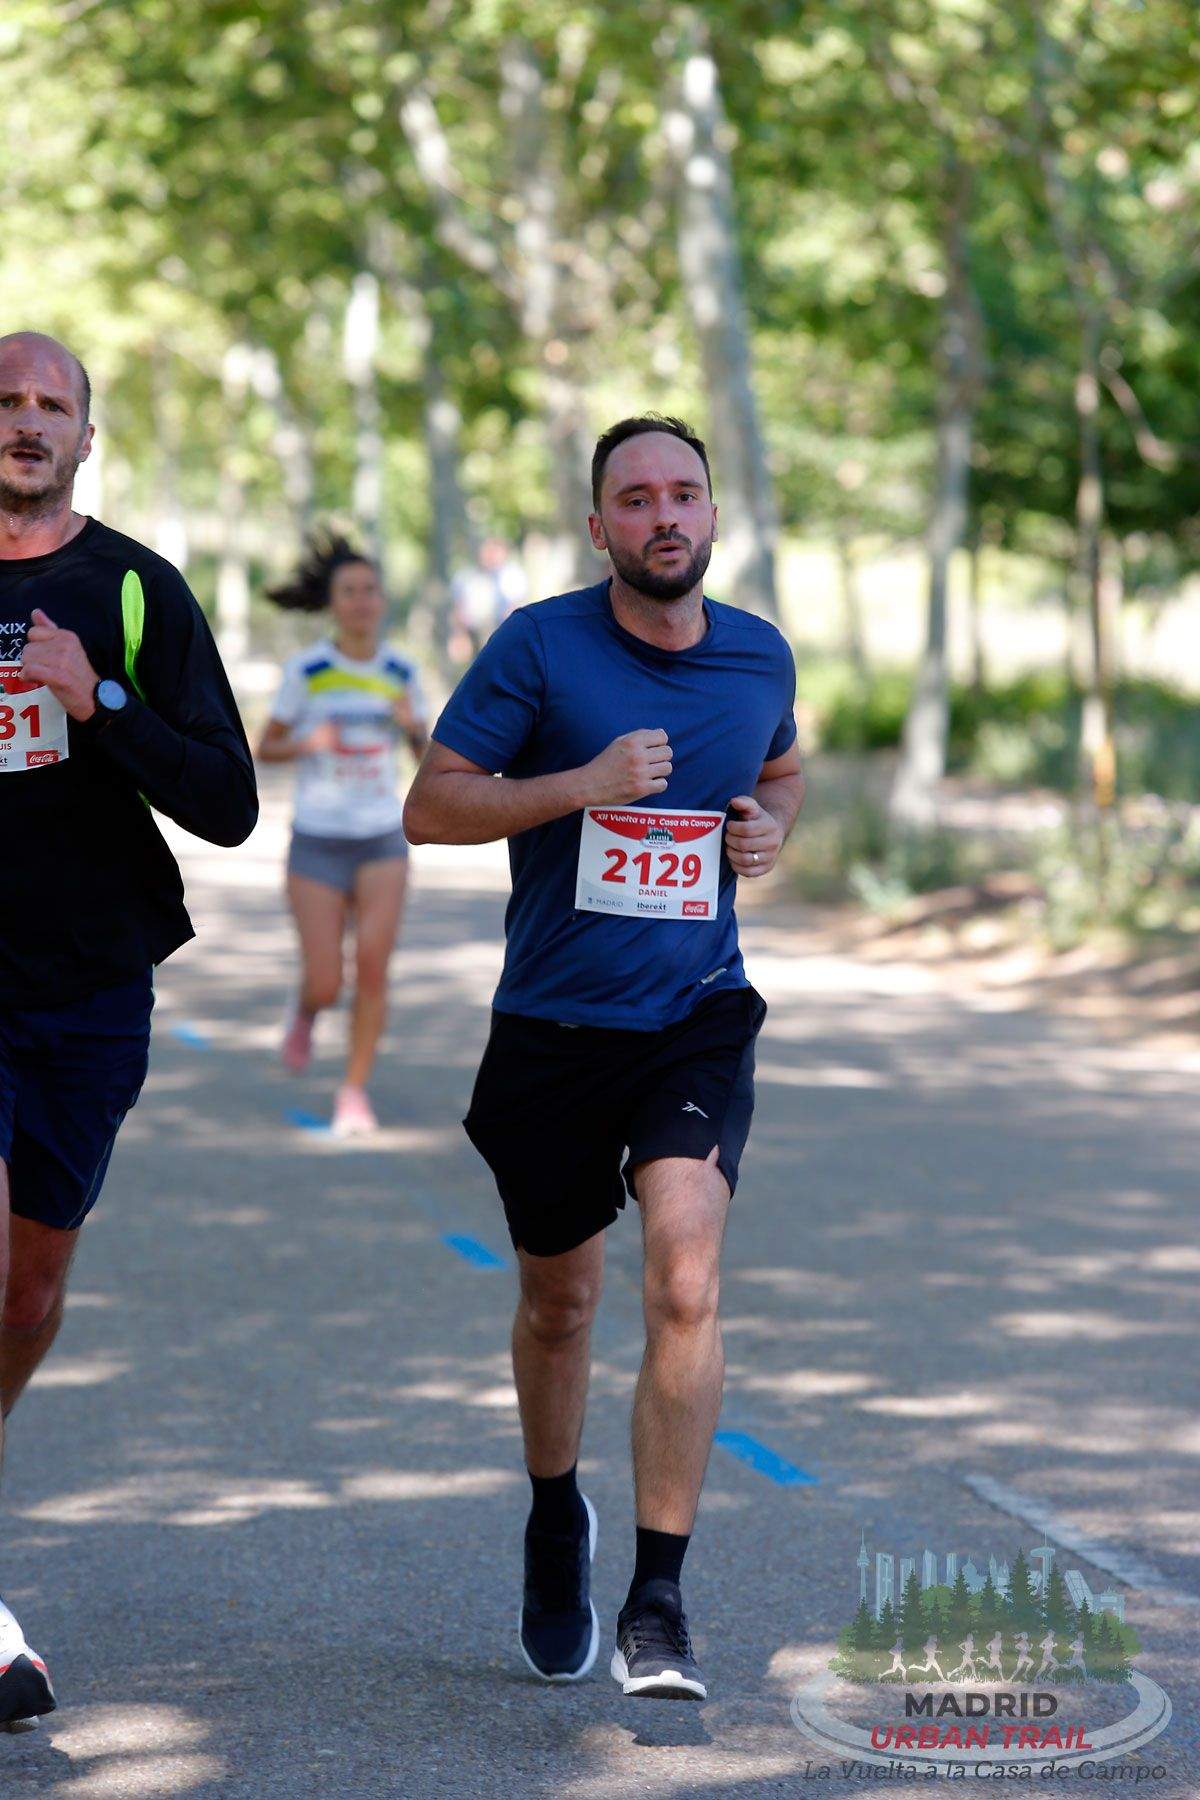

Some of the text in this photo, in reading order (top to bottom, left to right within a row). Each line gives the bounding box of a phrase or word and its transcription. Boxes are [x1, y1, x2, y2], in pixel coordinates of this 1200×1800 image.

[610, 814, 638, 823] Vuelta
[647, 816, 656, 825] la
[659, 816, 679, 826] Casa
[680, 818, 689, 826] de
[690, 818, 715, 828] Campo
[601, 848, 702, 888] 2129
[638, 888, 668, 898] DANIEL
